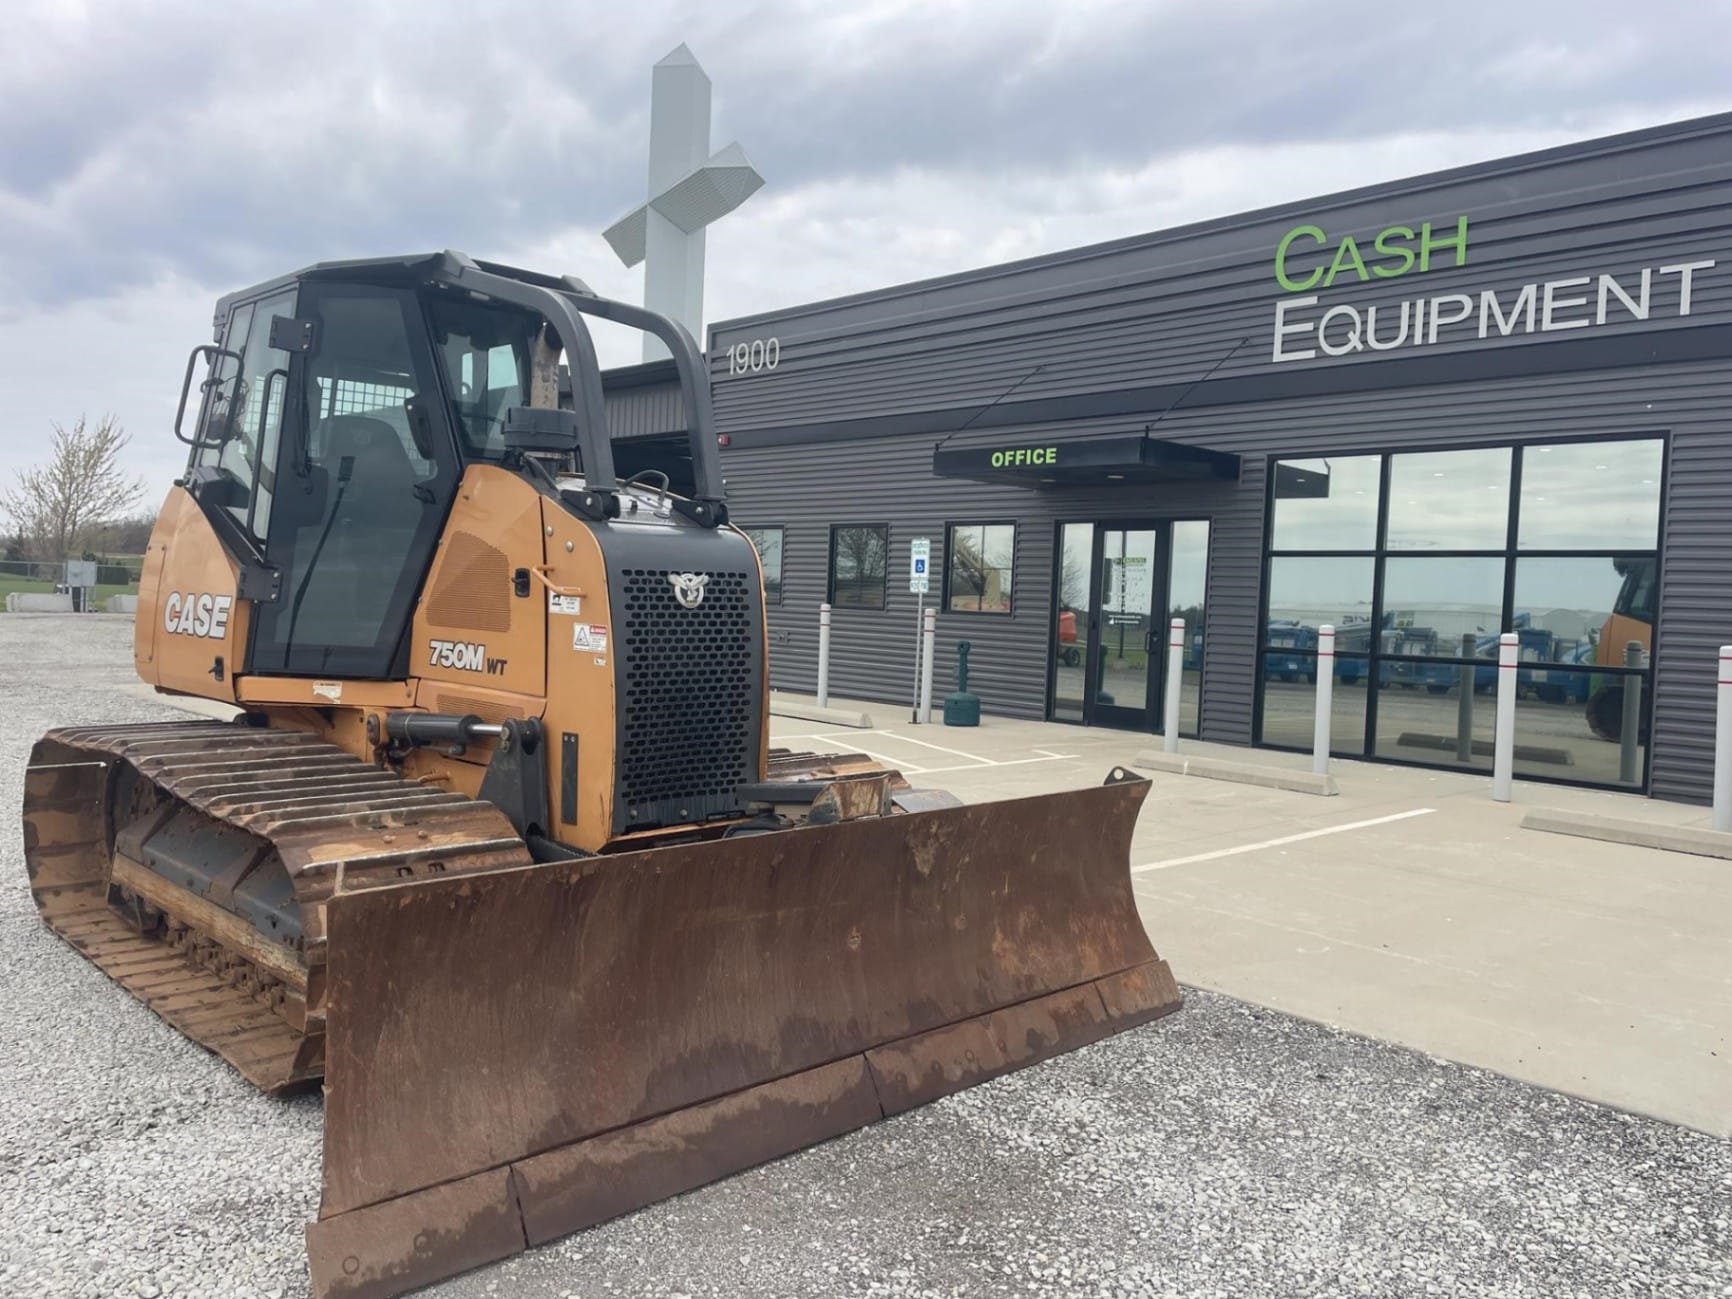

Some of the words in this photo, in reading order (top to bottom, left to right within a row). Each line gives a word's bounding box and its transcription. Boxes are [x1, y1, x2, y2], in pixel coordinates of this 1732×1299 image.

[1274, 215, 1468, 292] CASH
[1272, 259, 1716, 363] EQUIPMENT
[726, 337, 780, 375] 1900
[991, 447, 1057, 468] OFFICE
[164, 591, 232, 640] CASE
[429, 639, 486, 672] 750M
[487, 658, 507, 675] WT
